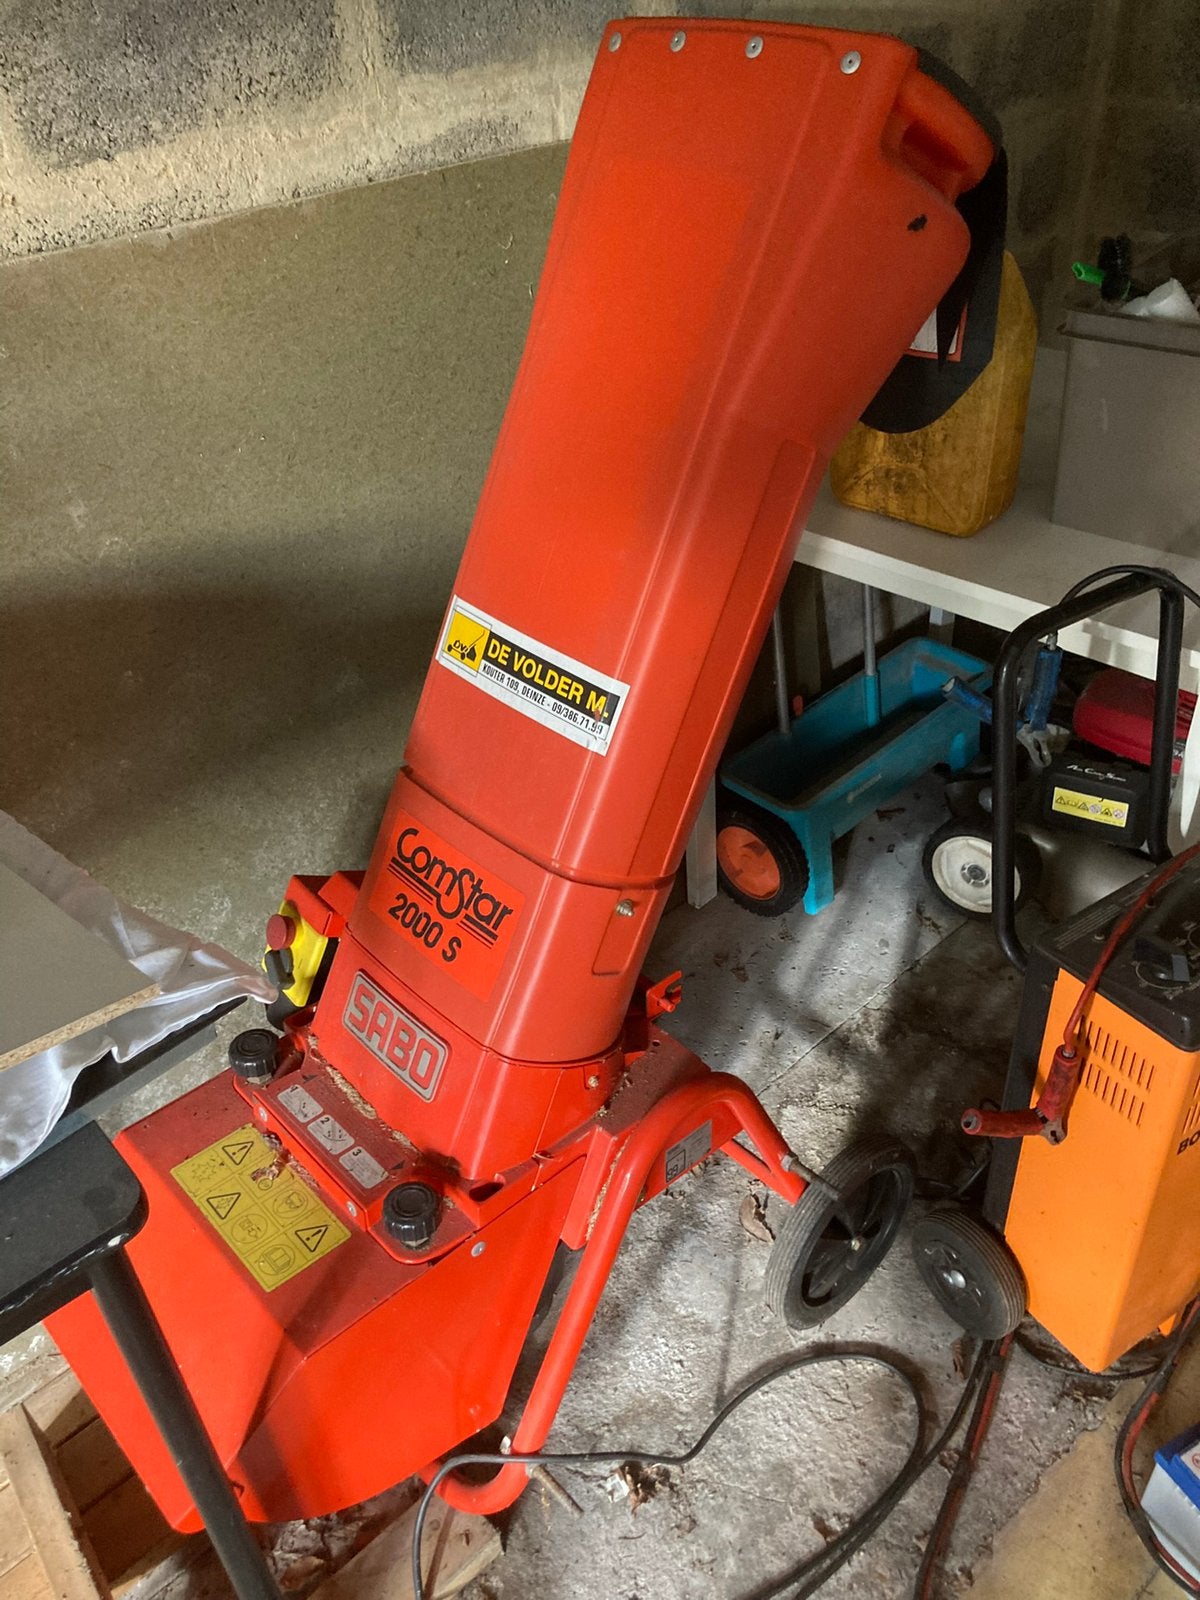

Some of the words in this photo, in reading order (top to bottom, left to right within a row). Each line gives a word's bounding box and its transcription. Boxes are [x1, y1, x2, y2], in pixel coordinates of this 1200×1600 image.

[482, 663, 505, 684] KOUTER
[506, 677, 520, 694] 109,
[521, 685, 546, 706] DEINZE
[487, 638, 511, 666] DE
[513, 651, 584, 705] VOLDER
[396, 827, 514, 930] ComStar
[388, 893, 444, 949] 2000
[441, 936, 463, 963] S
[353, 982, 440, 1090] SABO
[320, 1117, 330, 1125] 2
[352, 1148, 362, 1157] 3
